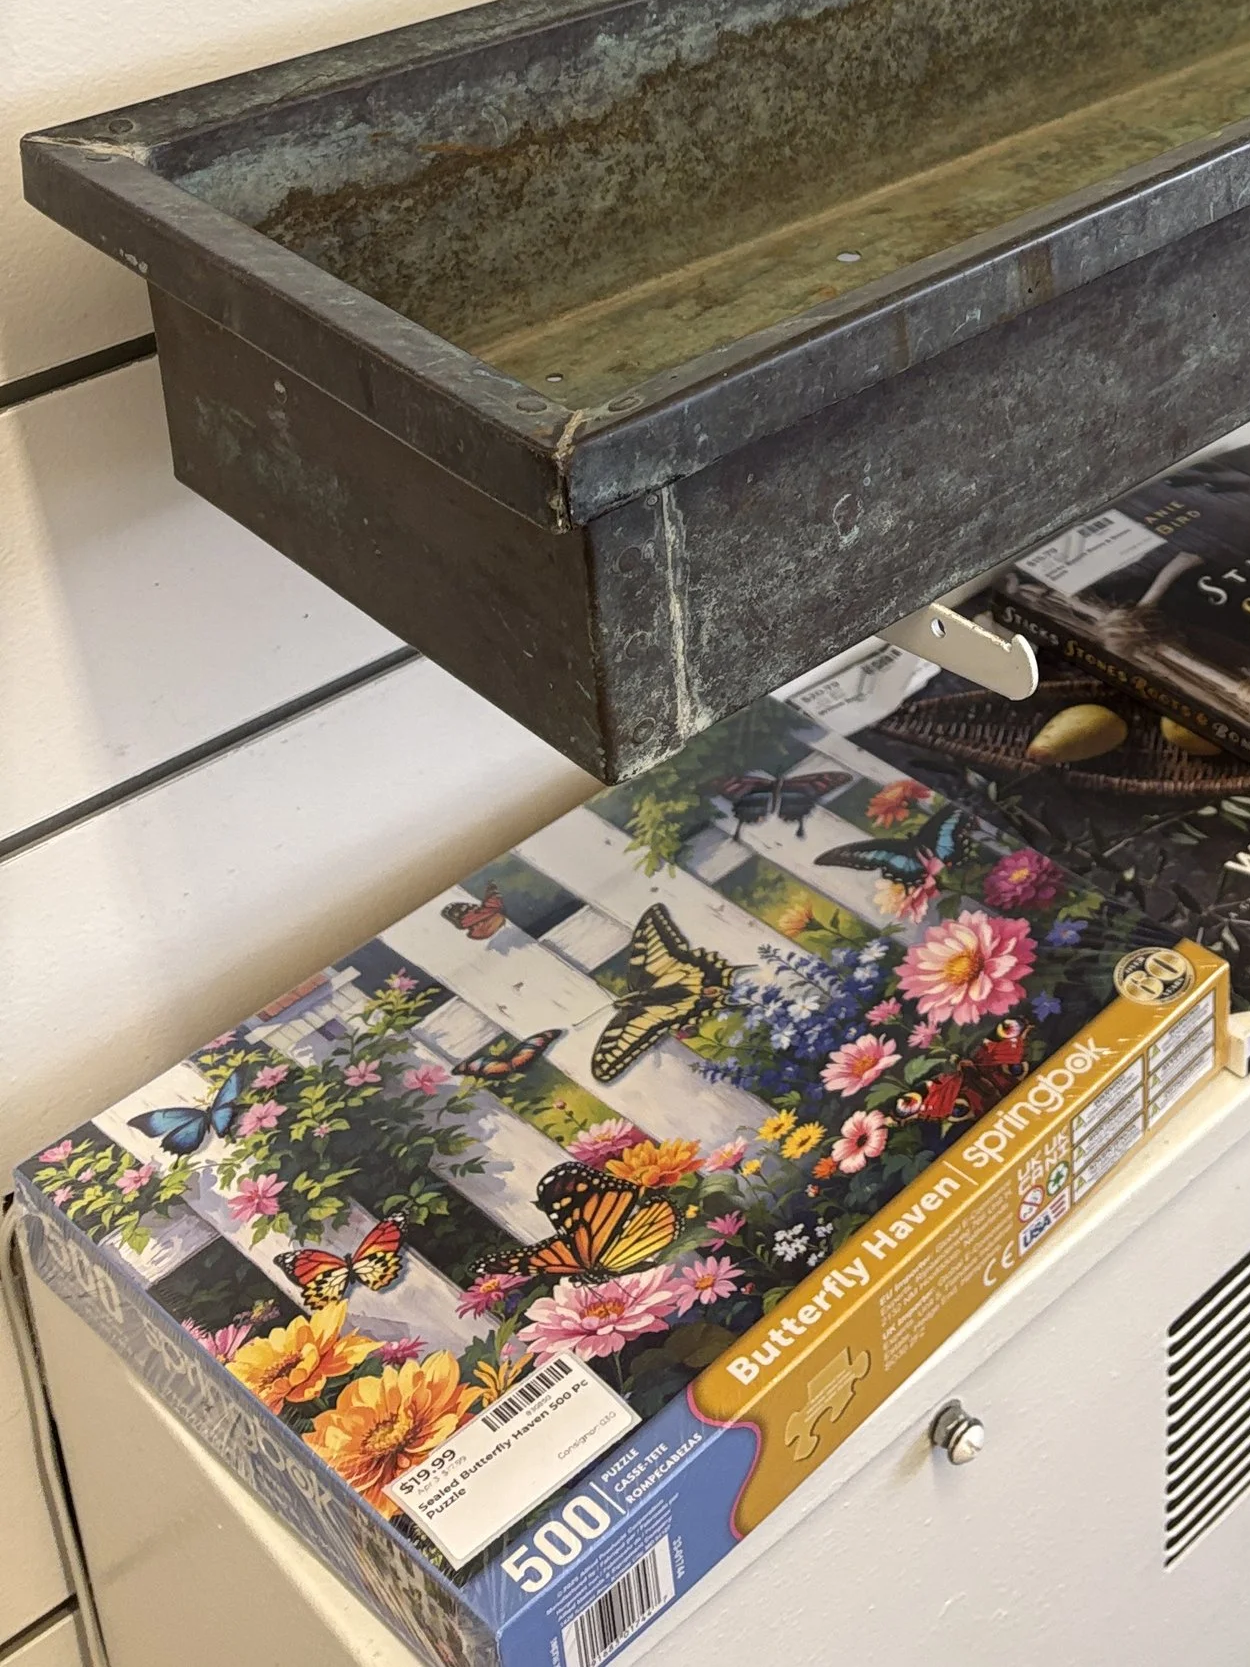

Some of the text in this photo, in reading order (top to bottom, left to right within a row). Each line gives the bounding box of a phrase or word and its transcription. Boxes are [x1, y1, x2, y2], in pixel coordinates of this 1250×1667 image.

[1144, 500, 1185, 525] ANIE
[1155, 510, 1201, 536] BIRD
[1123, 951, 1187, 1001] 60
[963, 1037, 1110, 1169] springbok
[1023, 1214, 1052, 1248] USA
[726, 1256, 871, 1386] Butterfly
[861, 1175, 961, 1260] Haven
[416, 1377, 589, 1513] Sealed Butterfly Haven 500 Pc
[601, 1448, 640, 1483] PUZZLE
[614, 1442, 669, 1493] CASSE-TETE
[625, 1433, 703, 1504] ROMPECABEZAS
[397, 1446, 459, 1496] $19.99
[415, 1480, 434, 1496] Apr
[424, 1485, 468, 1521] Puzzle
[501, 1495, 610, 1594] 500
